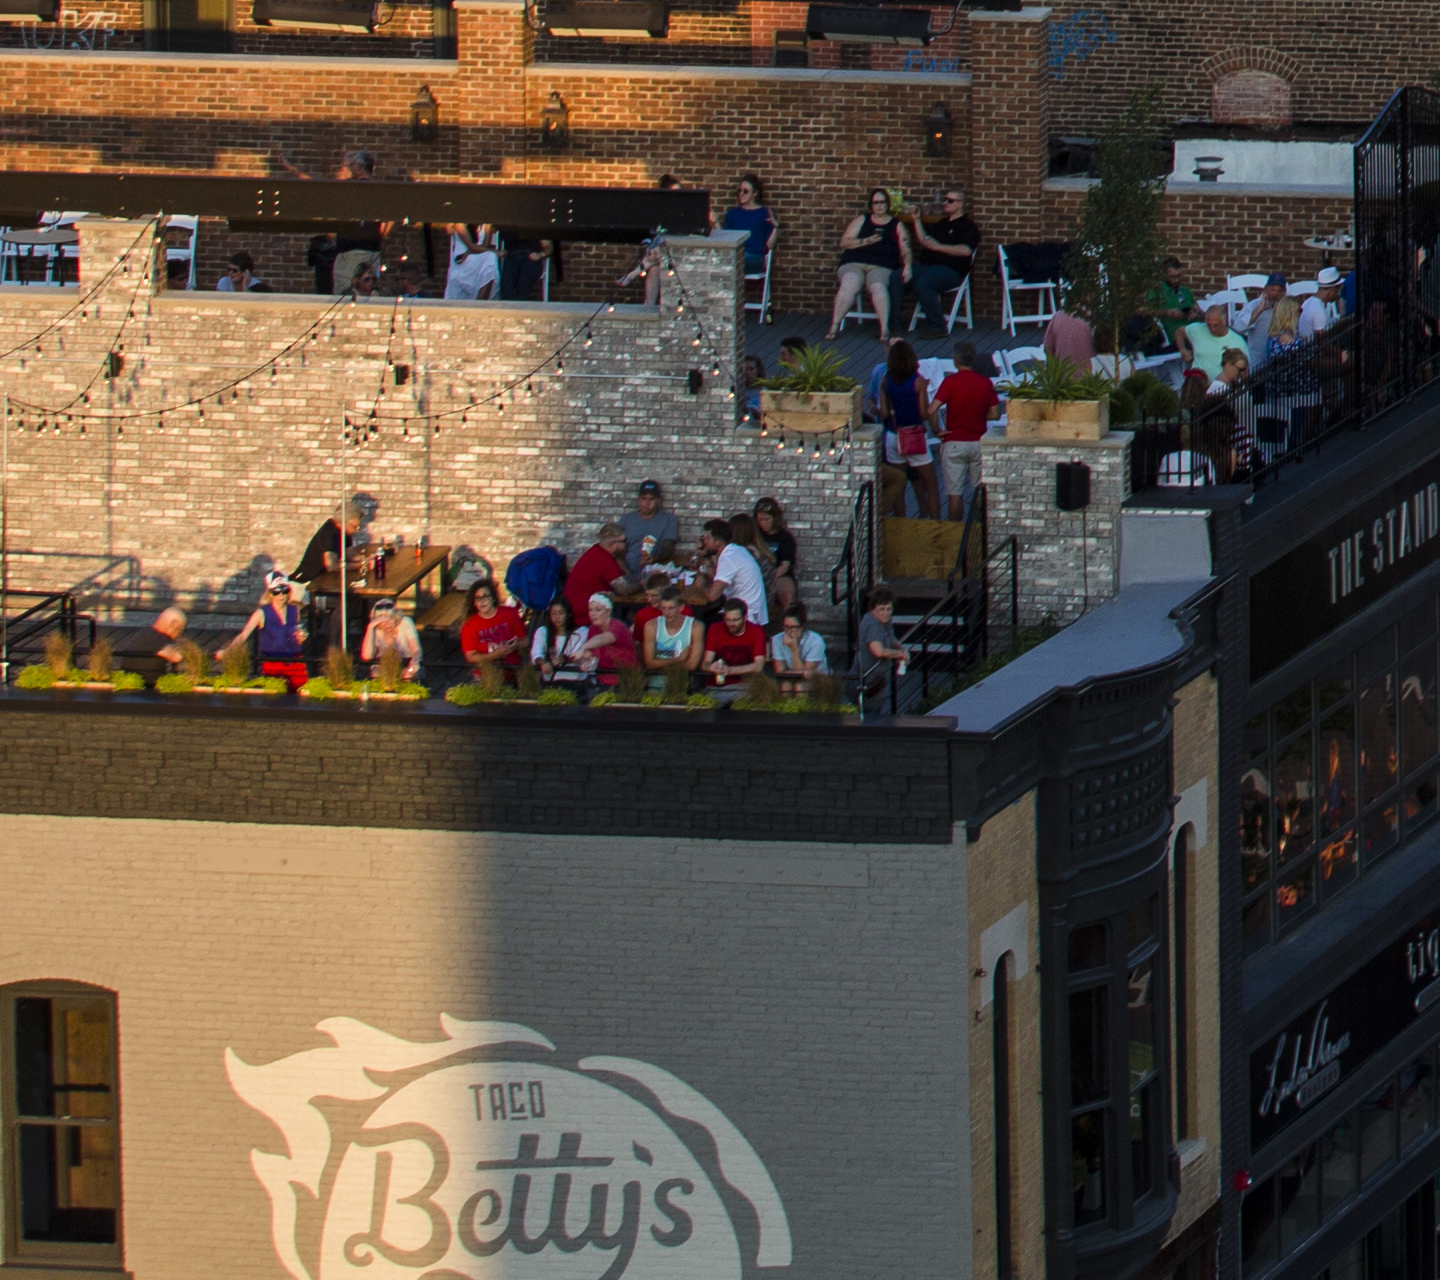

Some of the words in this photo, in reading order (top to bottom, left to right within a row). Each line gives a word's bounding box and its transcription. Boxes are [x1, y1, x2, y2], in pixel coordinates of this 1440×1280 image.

[1328, 530, 1365, 605] THE
[468, 1080, 547, 1122] TACO
[343, 1121, 696, 1280] Betty's
